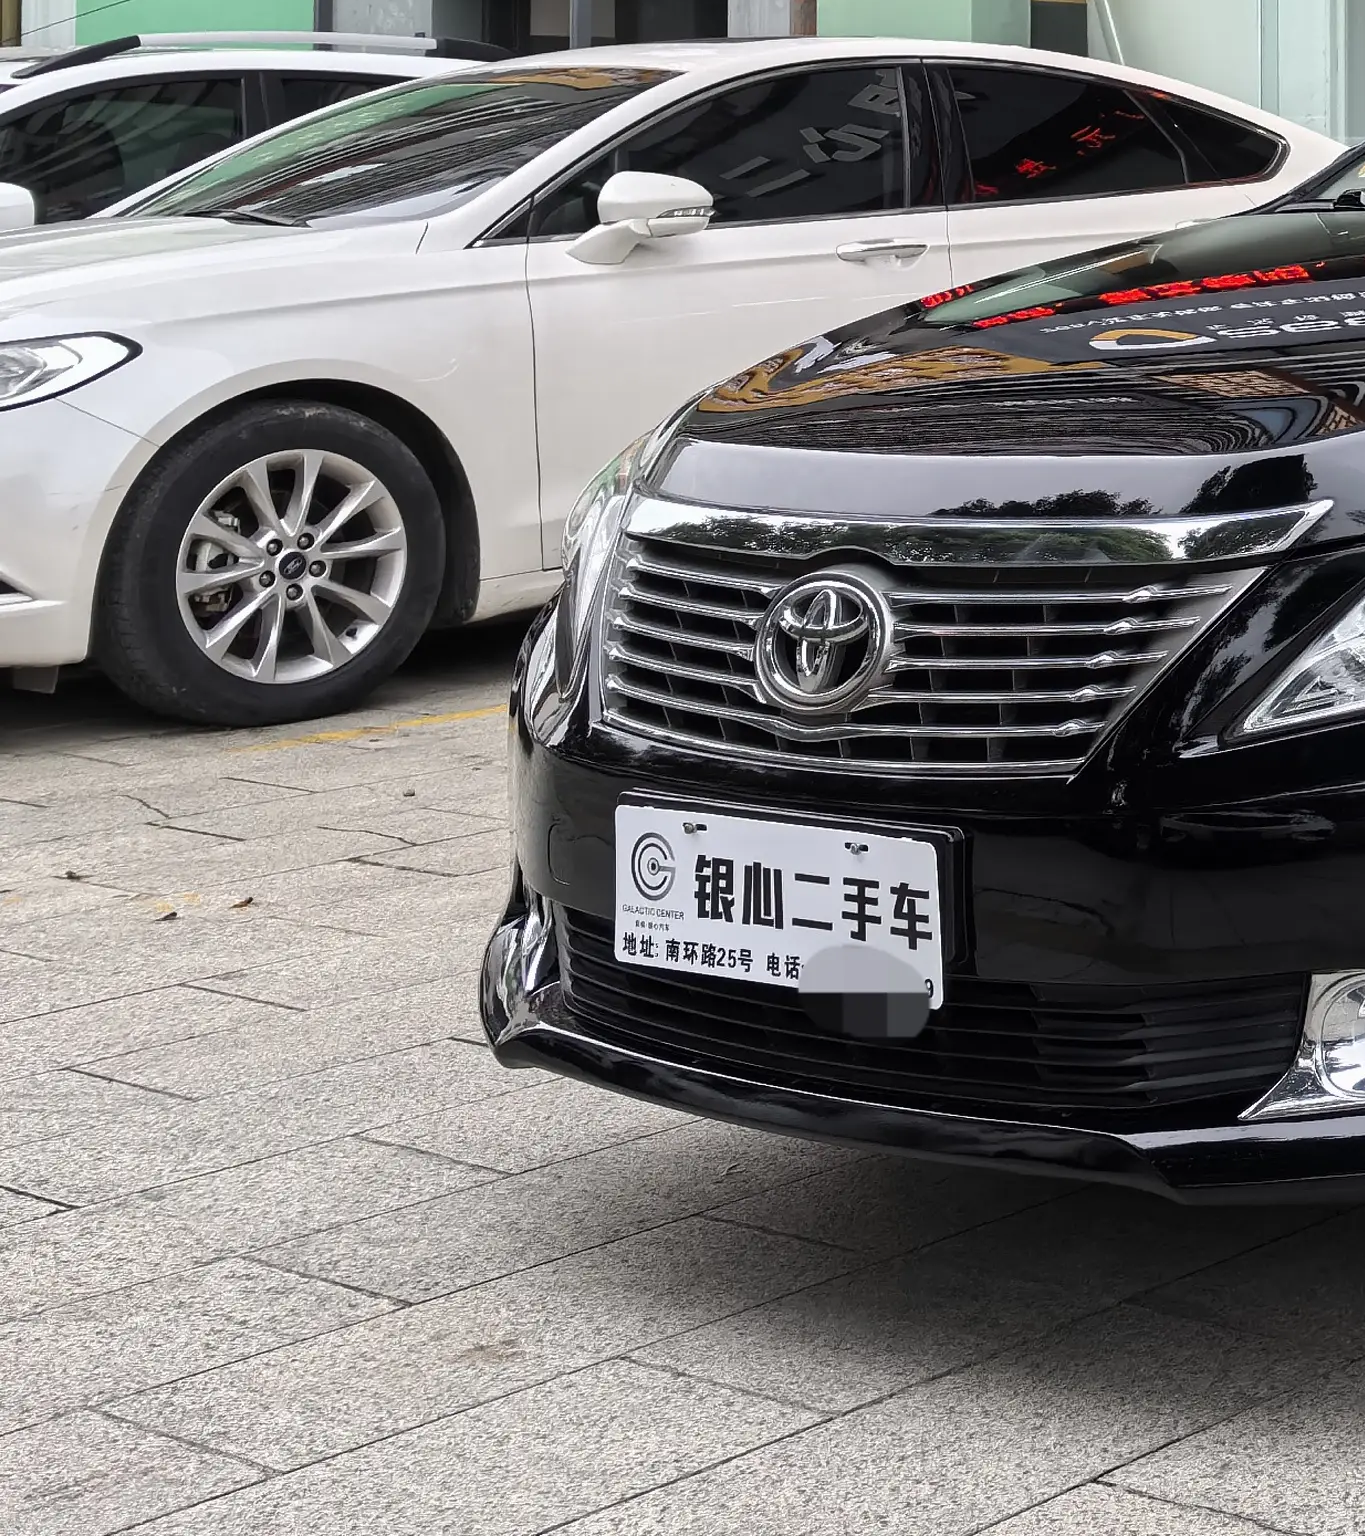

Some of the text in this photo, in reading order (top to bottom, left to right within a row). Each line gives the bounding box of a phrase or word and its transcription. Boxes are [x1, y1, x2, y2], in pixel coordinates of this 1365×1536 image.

[694, 854, 935, 951] 银心二手车
